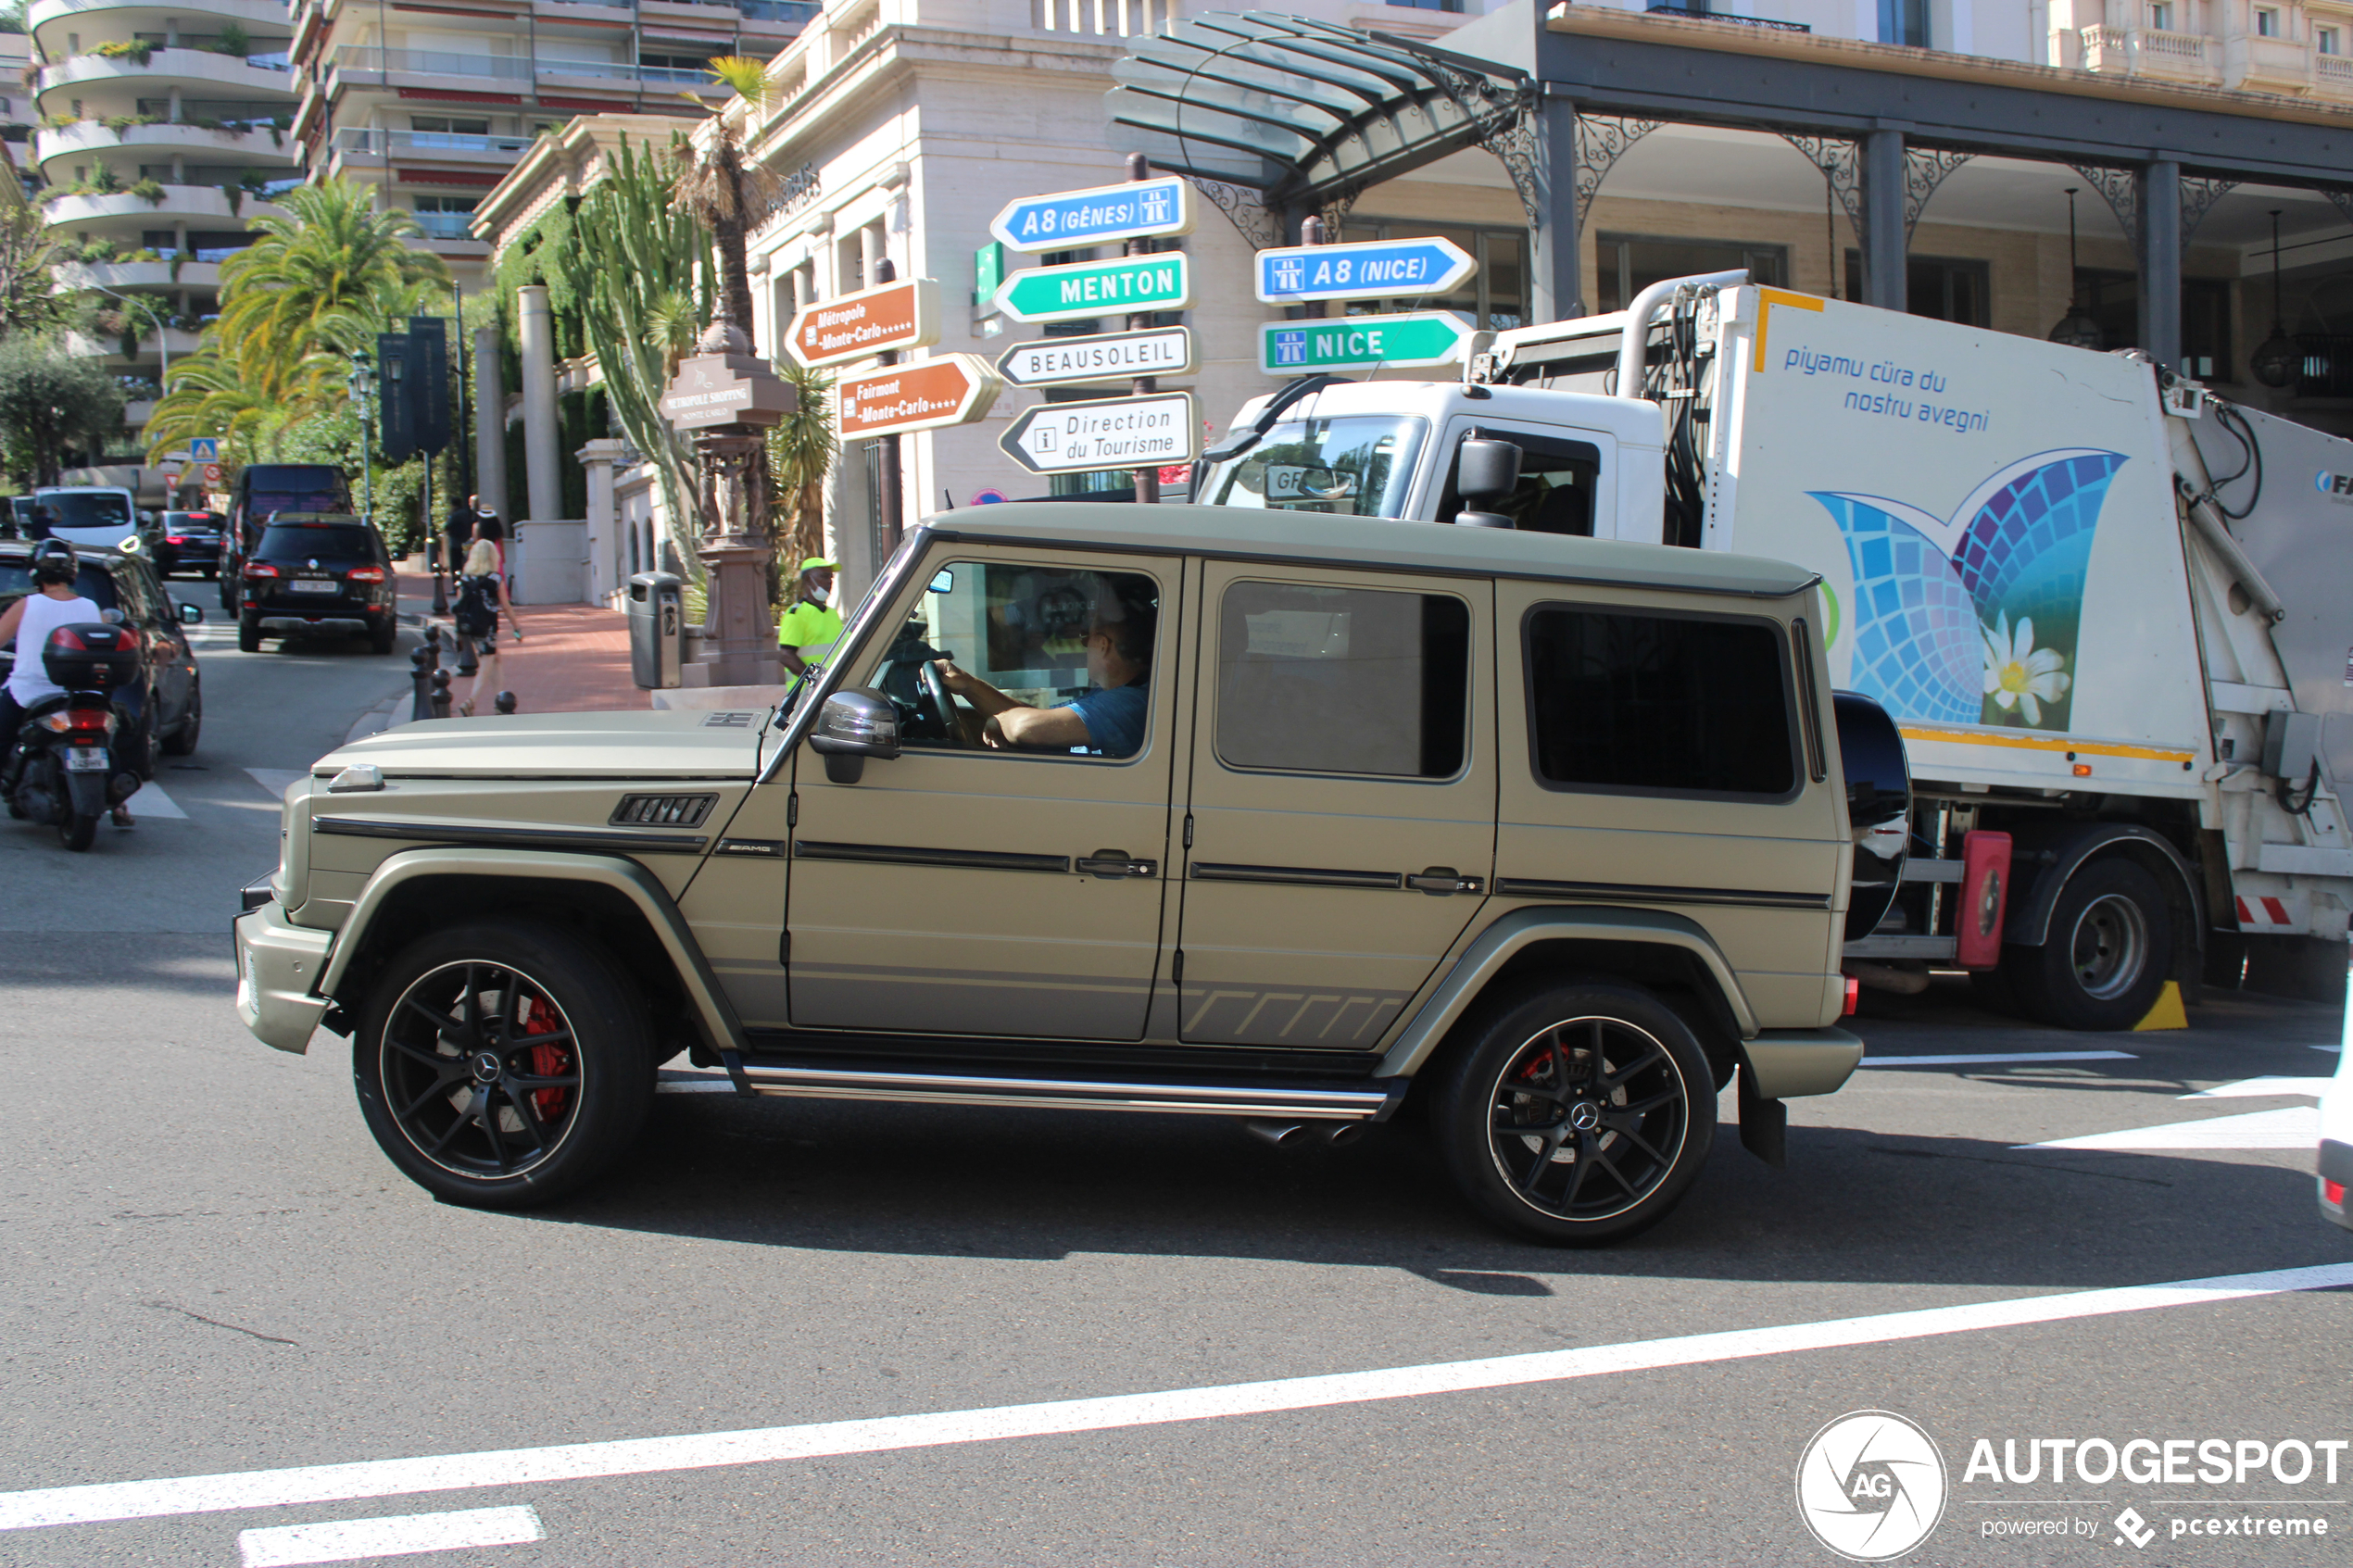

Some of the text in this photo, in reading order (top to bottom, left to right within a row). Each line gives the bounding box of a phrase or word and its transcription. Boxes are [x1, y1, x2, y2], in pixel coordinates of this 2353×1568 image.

[1022, 202, 1134, 236] A8 (GÊNES)
[1313, 257, 1428, 285] A8 (NICE)
[1061, 268, 1174, 304] MENTON
[817, 303, 866, 329] Métropole
[1030, 342, 1173, 373] BEAUSOLEIL
[1315, 331, 1384, 358] NICE
[1784, 345, 1946, 394] piyamu cüra du
[666, 387, 748, 410] METROPOLE SHOPPING
[856, 379, 900, 401] Fairmont
[681, 408, 705, 421] MONTE
[1844, 391, 1913, 419] nostru
[1066, 410, 1170, 435] Direction
[1067, 435, 1174, 459] du Tourisme
